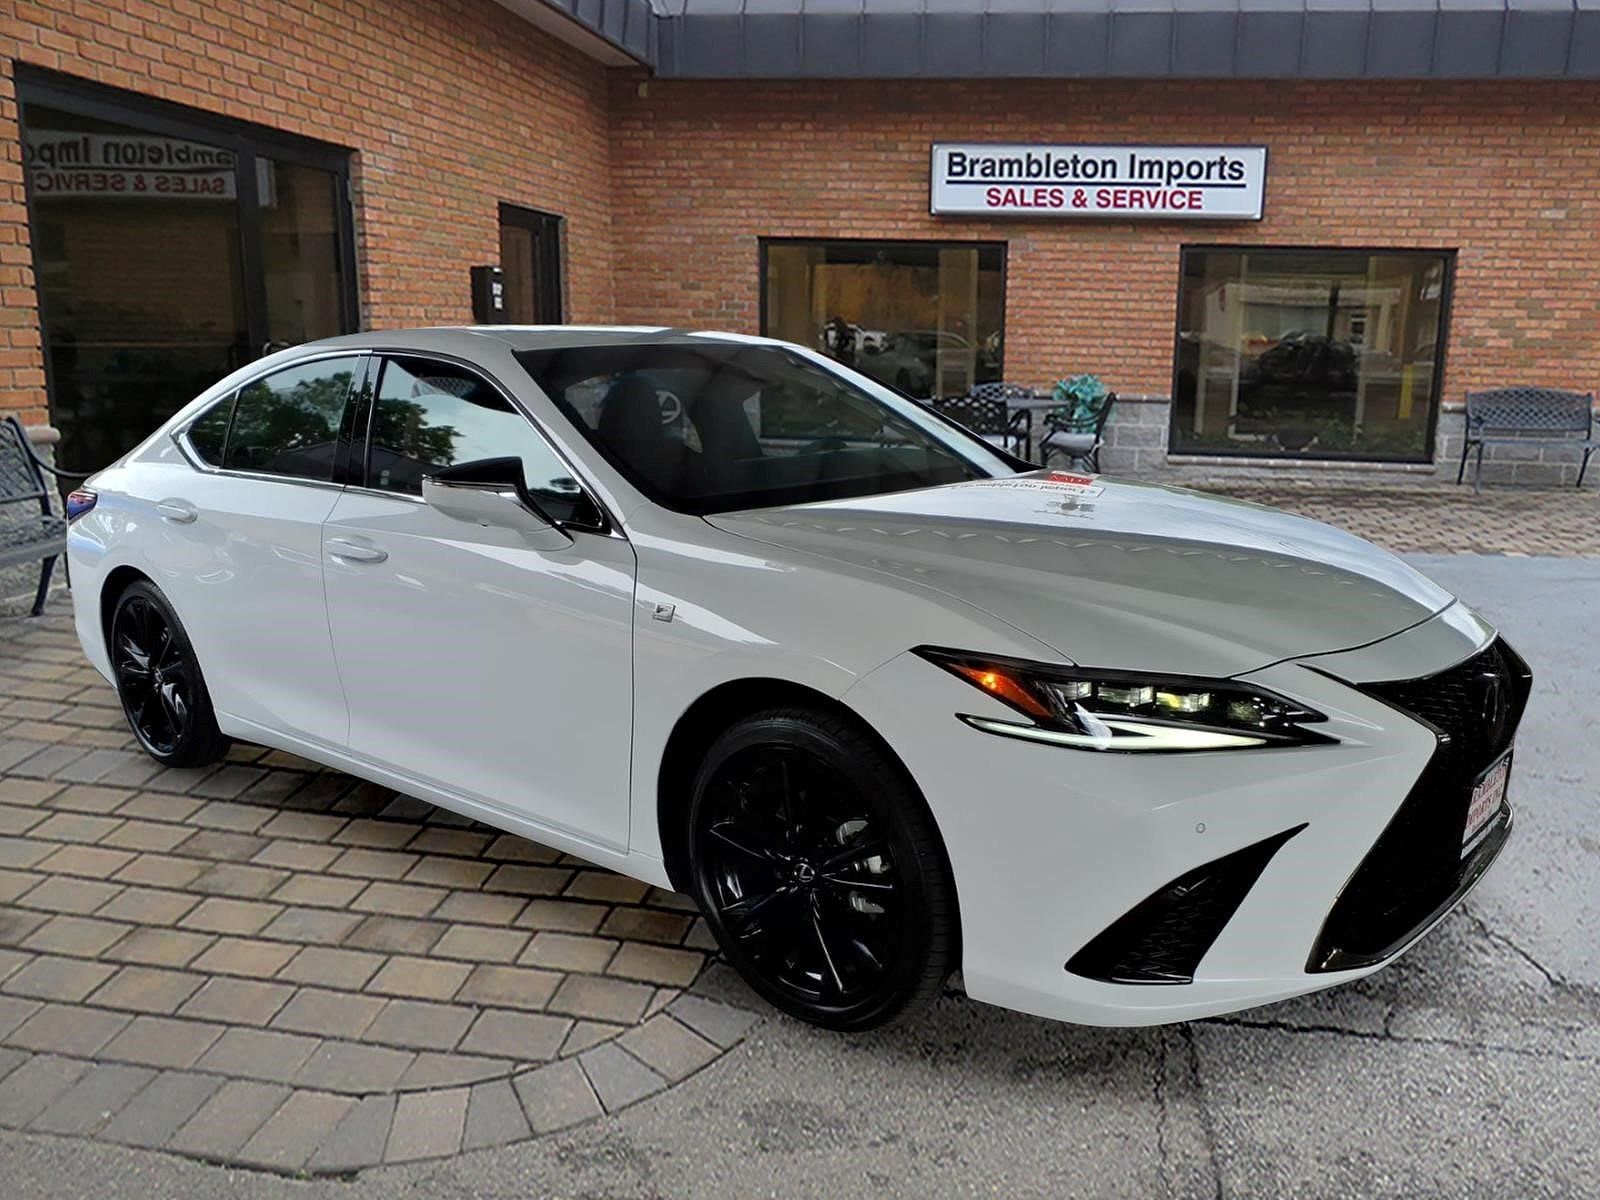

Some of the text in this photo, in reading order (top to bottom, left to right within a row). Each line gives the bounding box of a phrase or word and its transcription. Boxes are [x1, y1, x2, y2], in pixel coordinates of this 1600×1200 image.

[947, 151, 1246, 186] Brambleton Imports
[986, 187, 1204, 210] SALES & SERVICE
